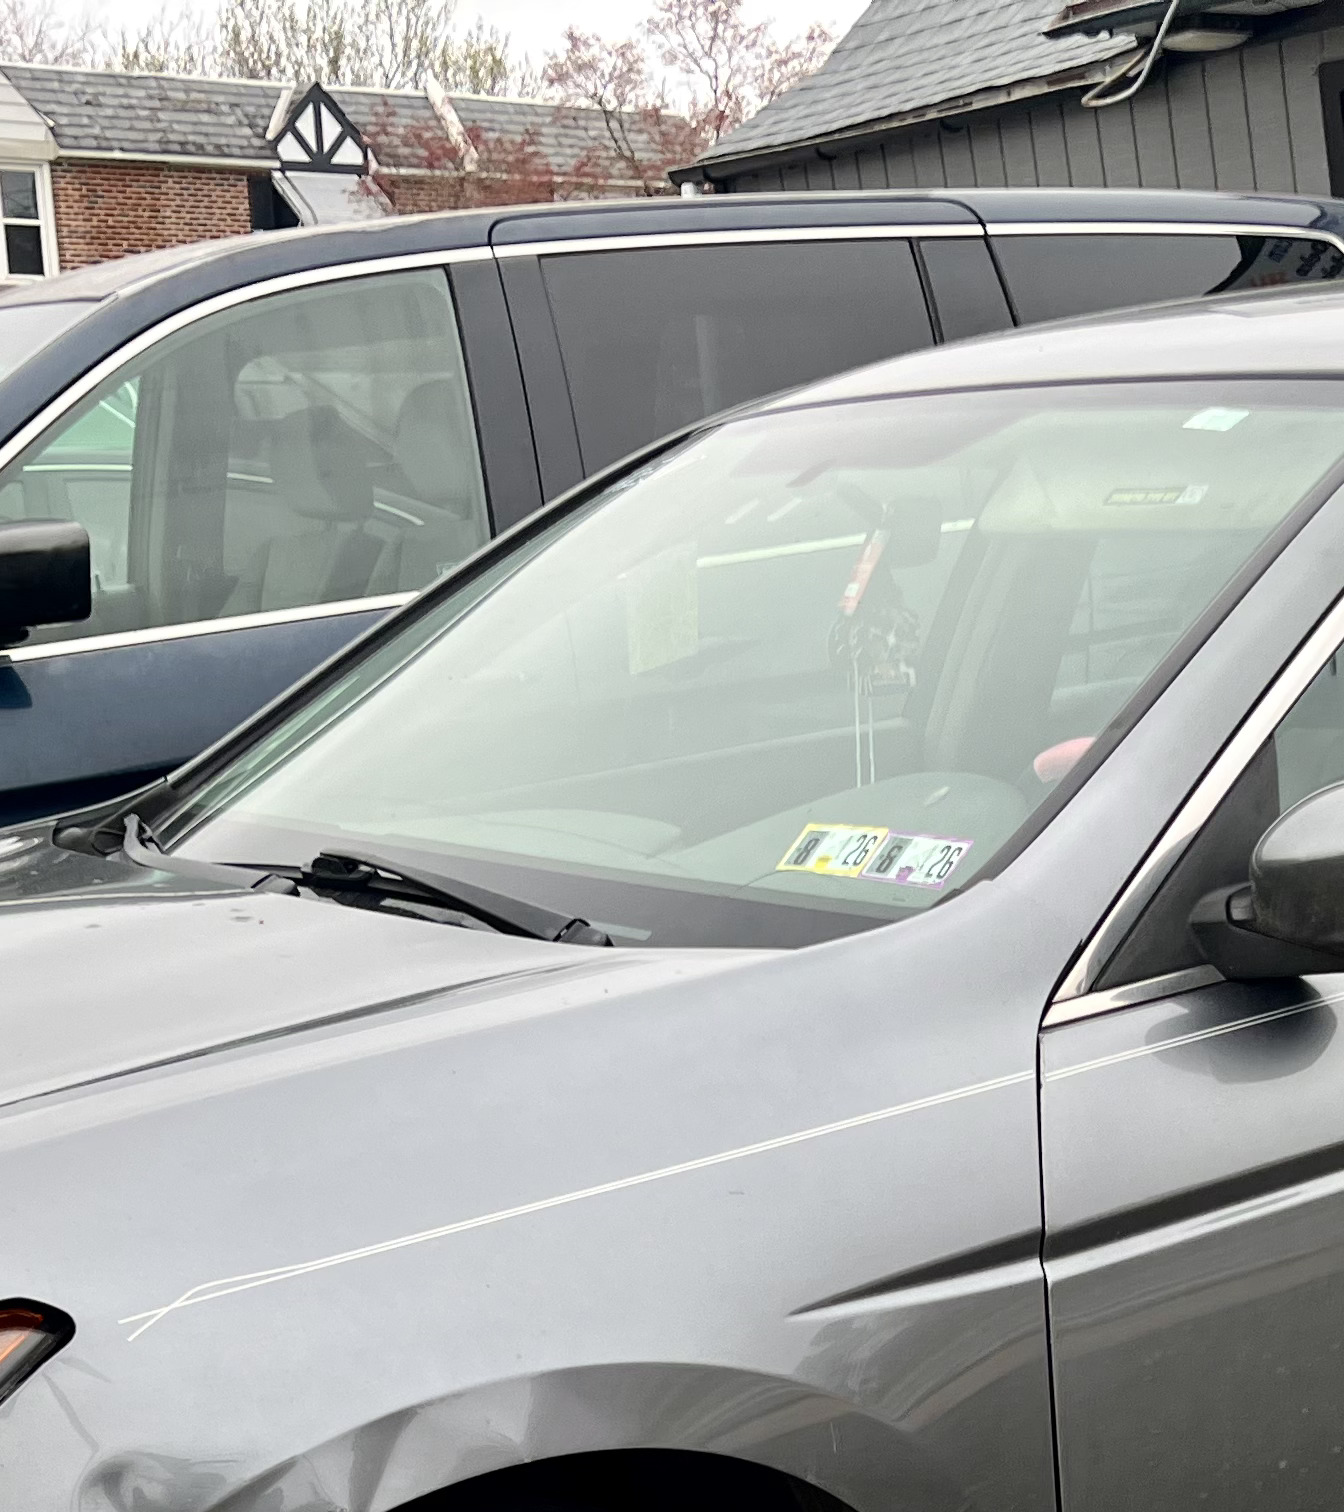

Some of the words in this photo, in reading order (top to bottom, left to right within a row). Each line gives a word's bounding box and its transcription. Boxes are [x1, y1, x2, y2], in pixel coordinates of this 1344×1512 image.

[793, 838, 821, 866] 8
[841, 834, 878, 867] 26
[875, 845, 903, 874] 8
[925, 845, 963, 880] 26
